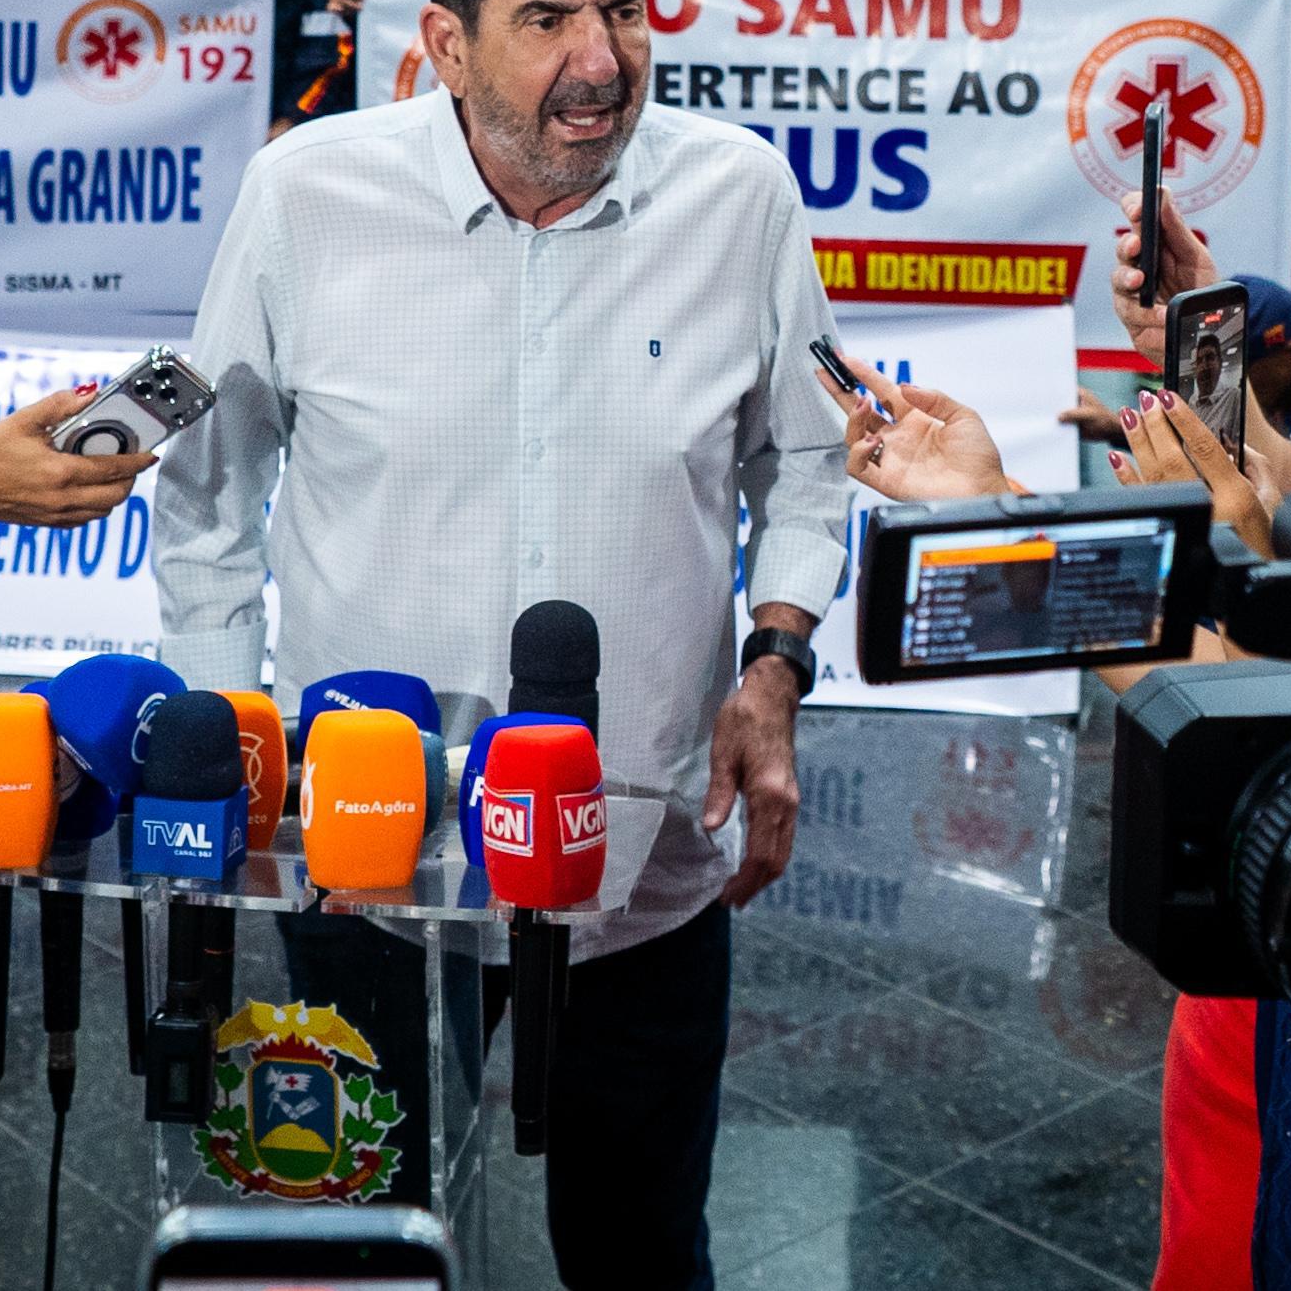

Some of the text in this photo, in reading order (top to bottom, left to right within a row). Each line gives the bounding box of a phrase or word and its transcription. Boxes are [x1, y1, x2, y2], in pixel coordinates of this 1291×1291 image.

[177, 13, 258, 37] SAMU
[178, 45, 256, 84] 192
[654, 63, 1041, 116] ERTENCE AO
[29, 146, 204, 224] GRANDE
[743, 124, 931, 213] US
[4, 273, 73, 294] SISMA
[91, 272, 123, 292] MT
[813, 250, 1067, 296] UA IDENTIDADE!
[142, 819, 213, 850] TVAL
[563, 798, 606, 840] VGN
